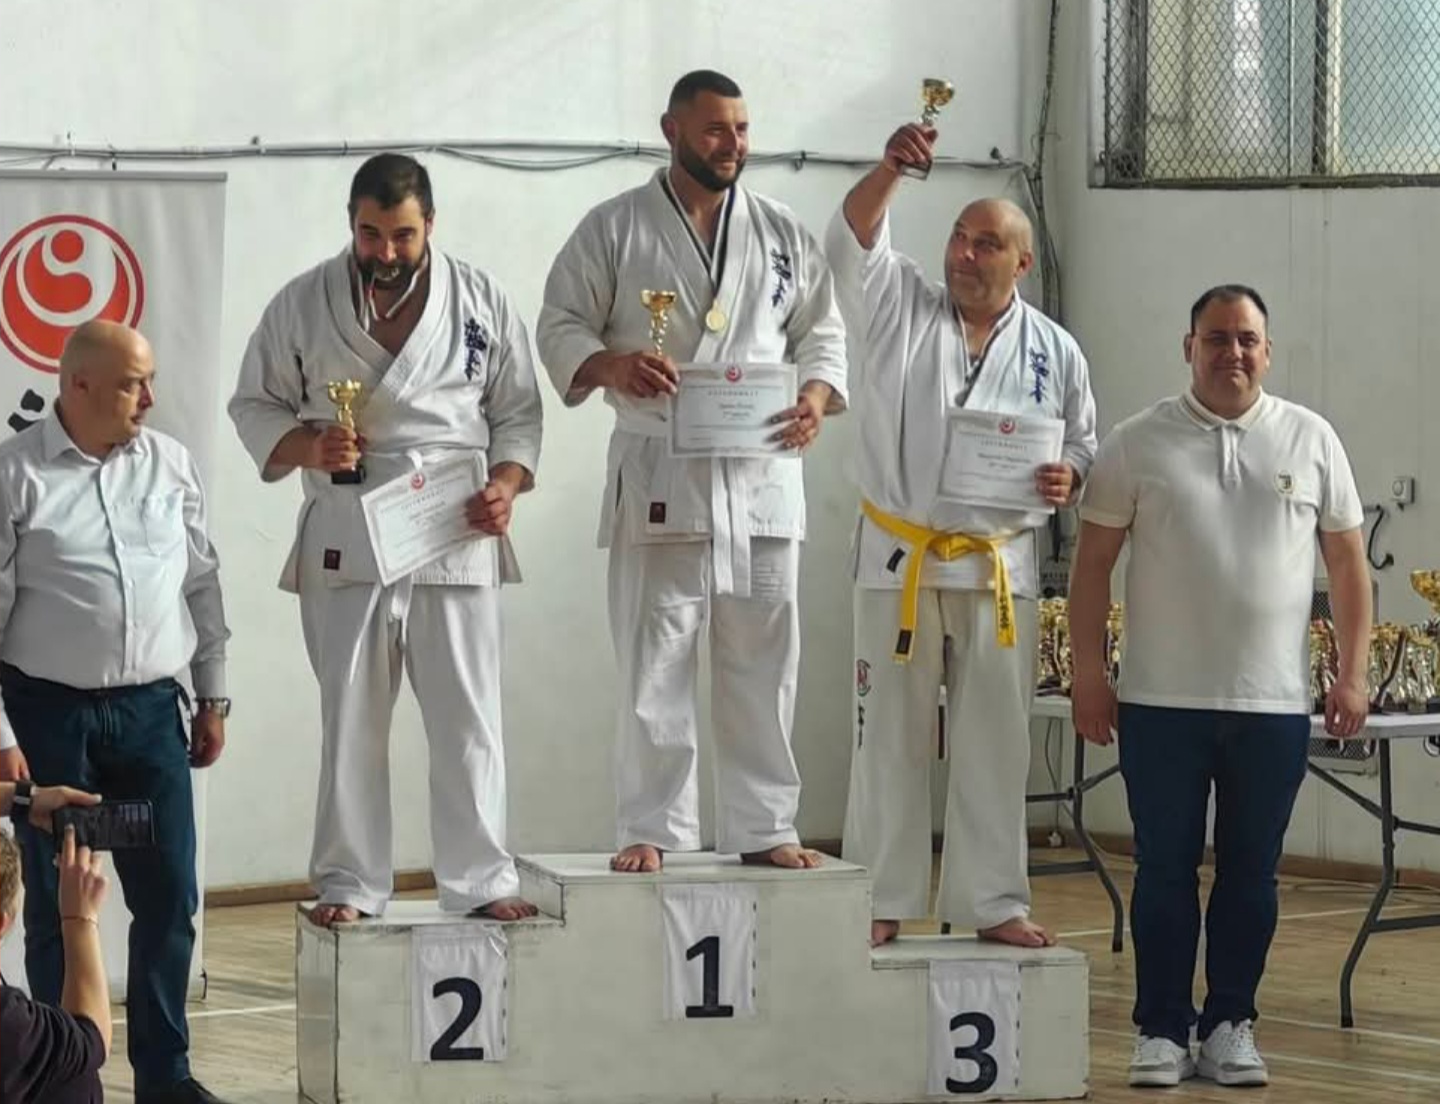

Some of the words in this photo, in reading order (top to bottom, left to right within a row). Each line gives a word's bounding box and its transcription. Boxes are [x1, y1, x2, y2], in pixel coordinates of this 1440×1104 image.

[686, 936, 734, 1019] 1
[429, 977, 485, 1062] 2
[946, 1012, 998, 1094] 3
